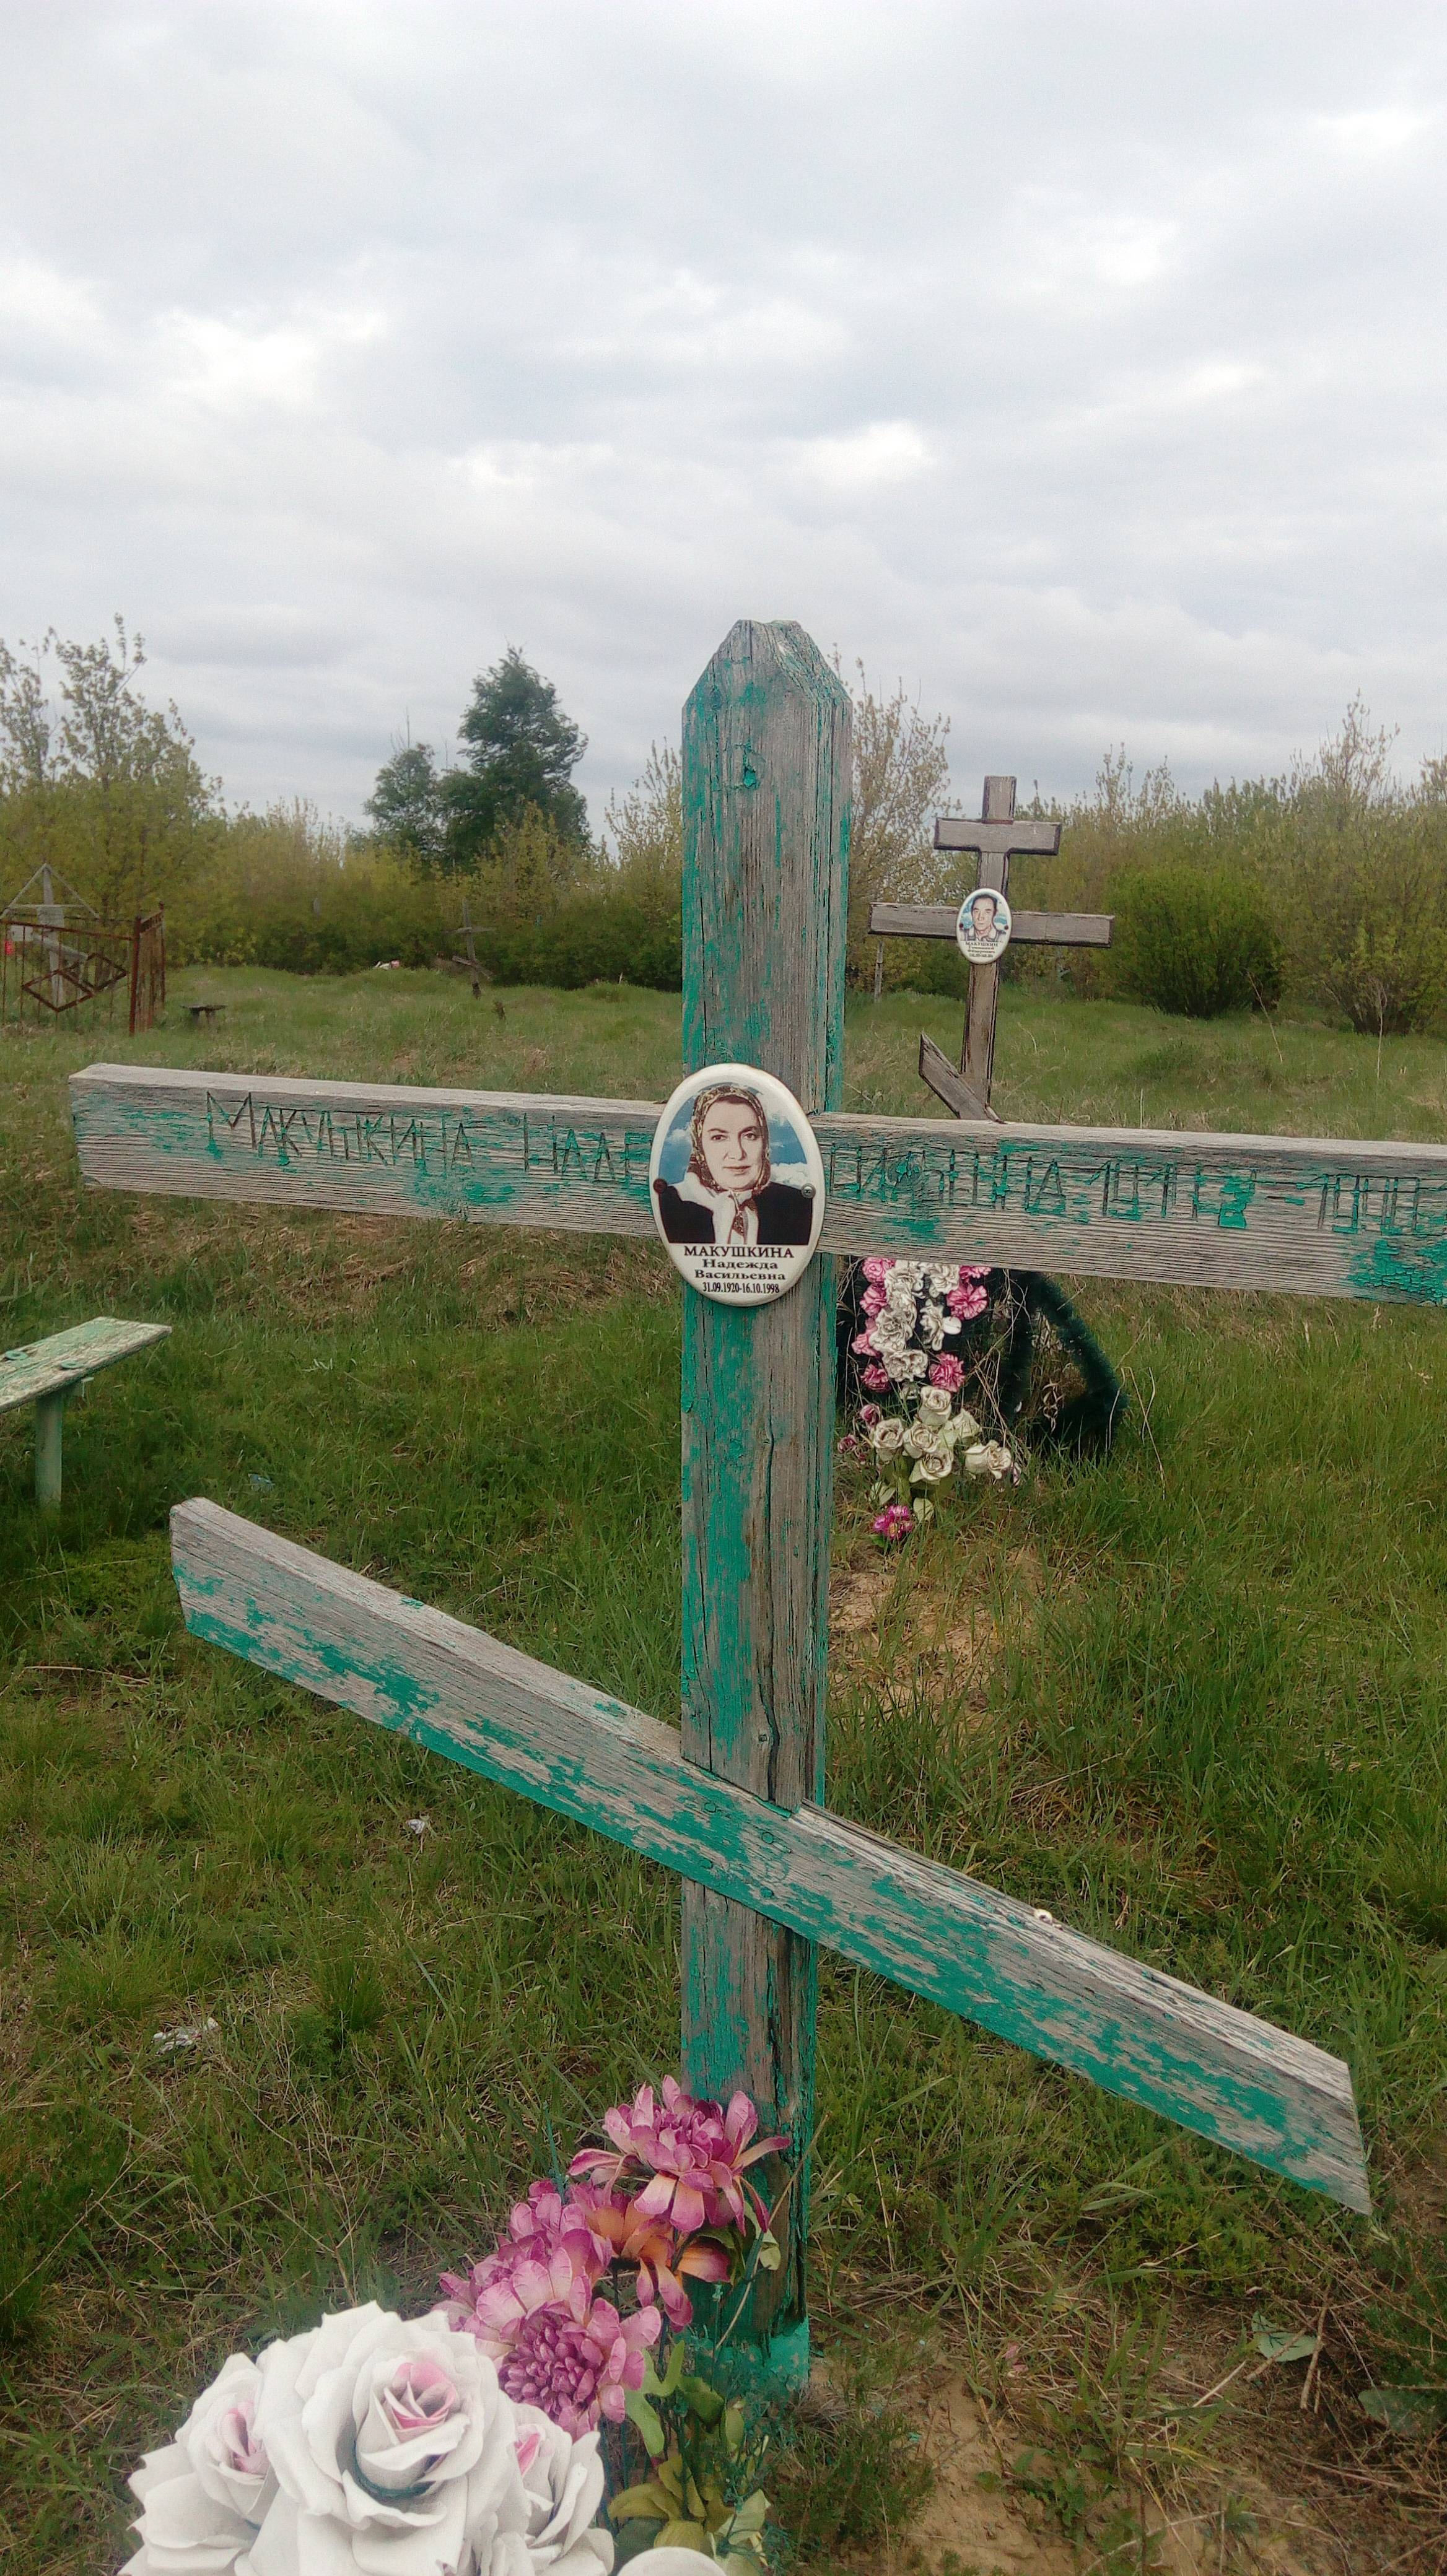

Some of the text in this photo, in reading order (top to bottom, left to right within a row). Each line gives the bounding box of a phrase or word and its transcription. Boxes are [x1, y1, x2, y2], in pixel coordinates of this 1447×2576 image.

[523, 1112, 653, 1179] НАДЕ
[684, 1245, 794, 1258] МАКУШКИНА
[702, 1259, 779, 1269] Надежда
[694, 1269, 785, 1280] Васильевна
